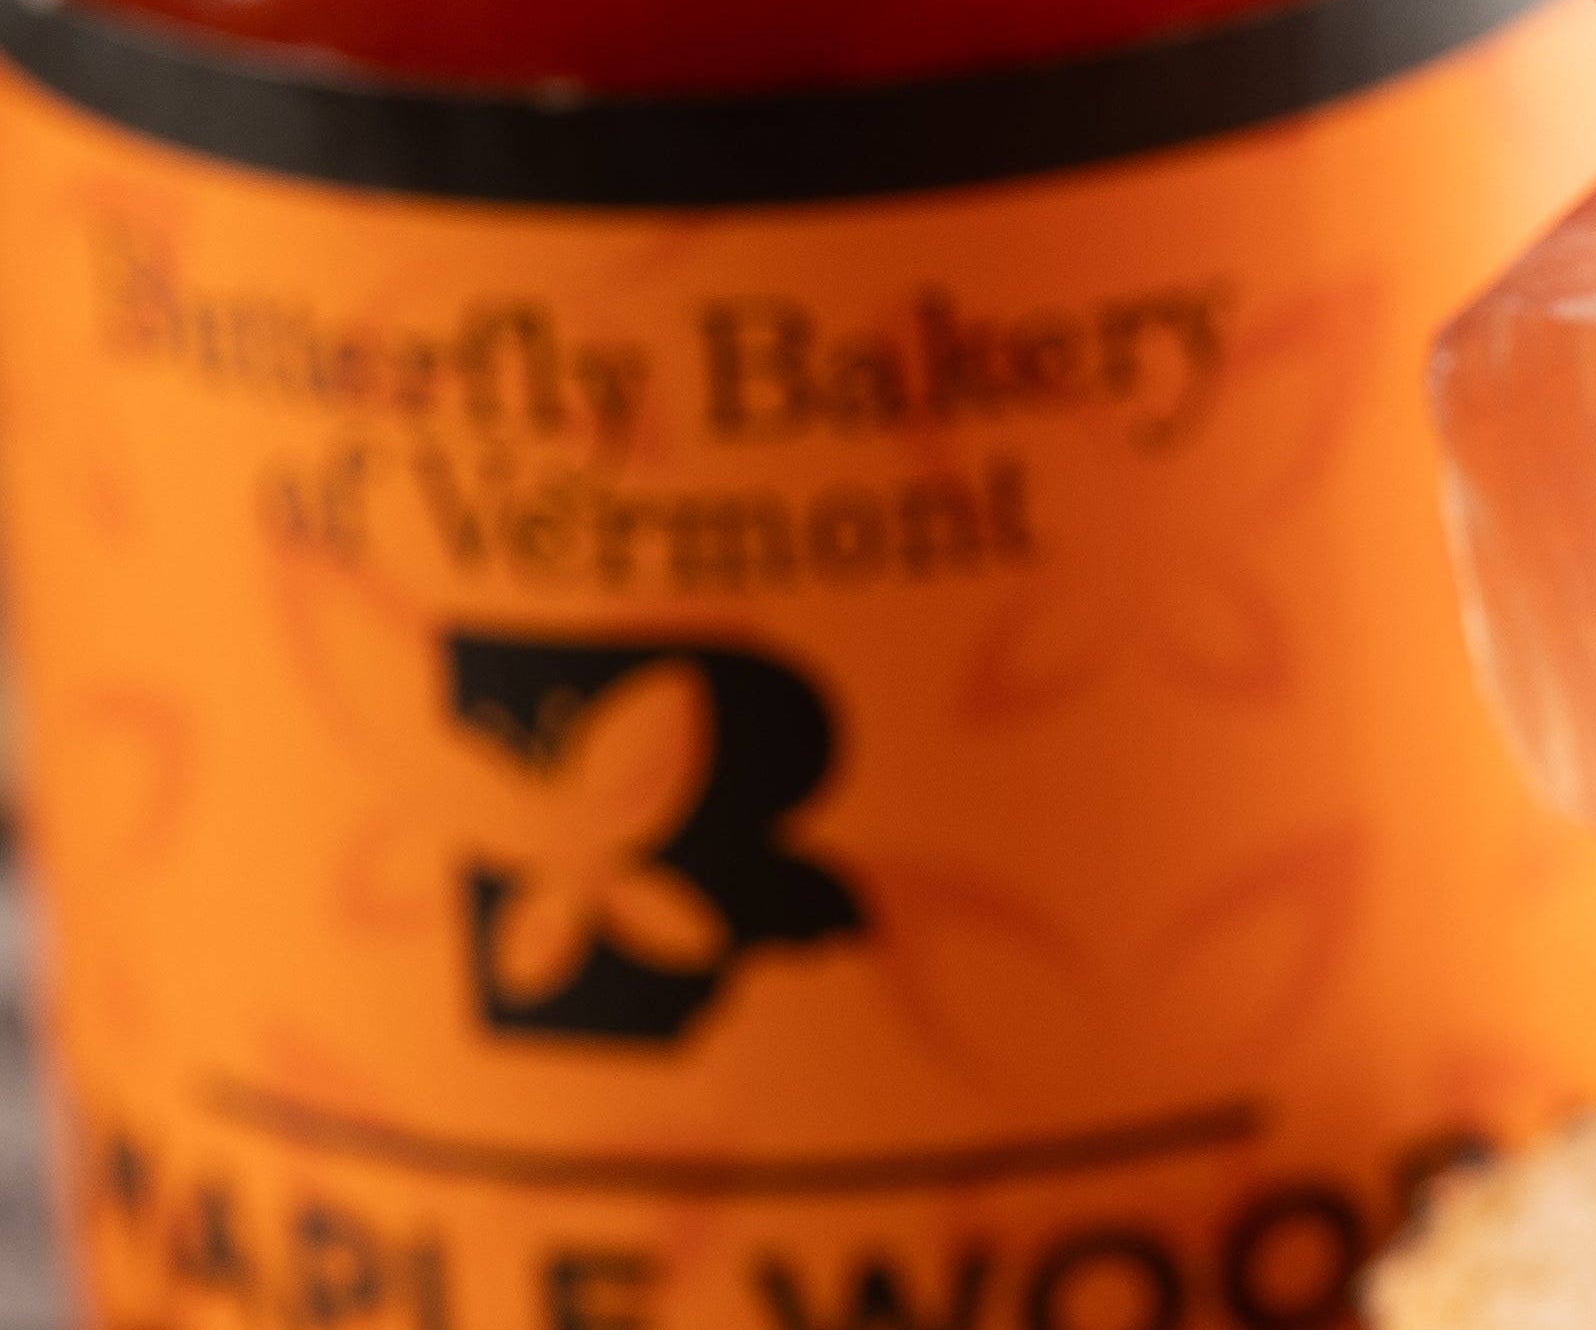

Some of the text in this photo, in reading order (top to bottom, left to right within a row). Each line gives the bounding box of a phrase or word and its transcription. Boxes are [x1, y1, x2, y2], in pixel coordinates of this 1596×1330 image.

[88, 200, 1236, 462] Butterfly Bakery
[252, 432, 1042, 596] of Vermont
